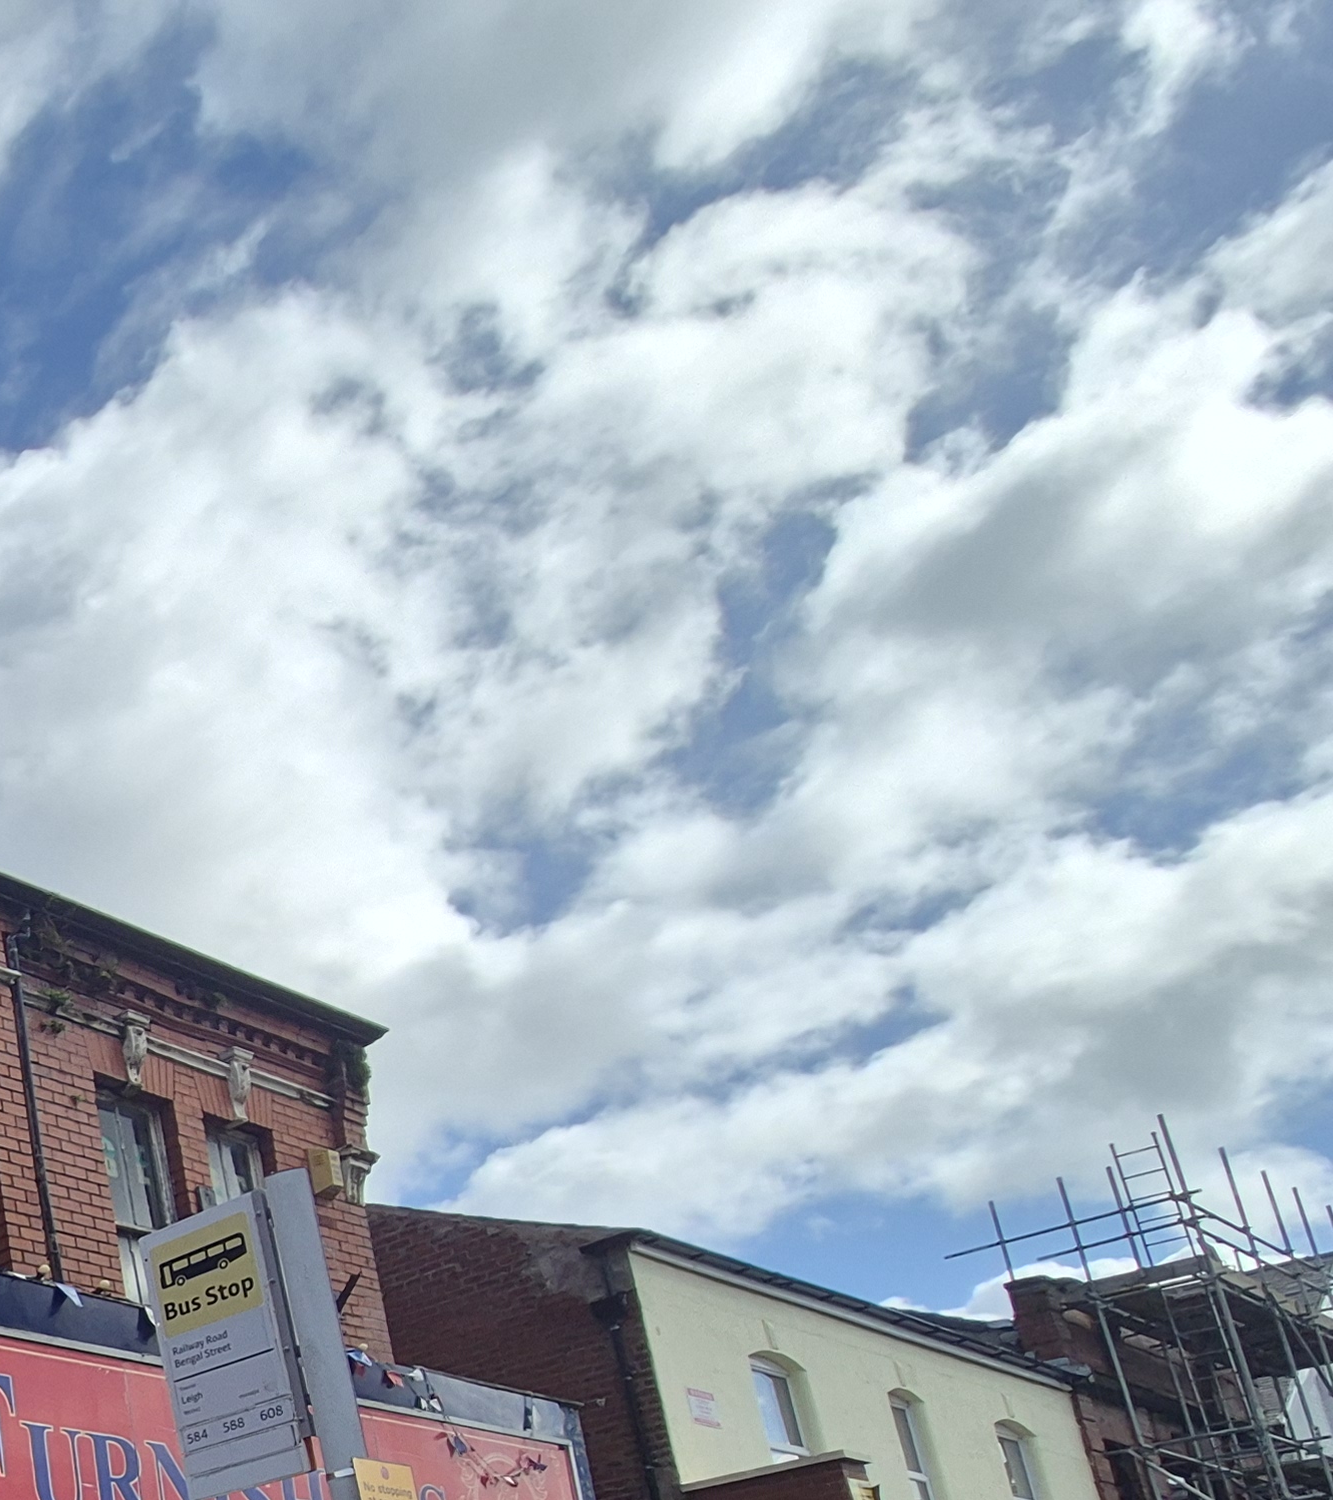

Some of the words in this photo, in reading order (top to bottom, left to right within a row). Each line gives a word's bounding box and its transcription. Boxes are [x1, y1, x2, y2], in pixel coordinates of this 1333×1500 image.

[163, 1294, 202, 1321] Bus
[205, 1275, 255, 1308] Stop
[172, 1340, 204, 1356] Railway
[206, 1330, 228, 1344] Road
[174, 1351, 203, 1368] Bengal
[205, 1343, 232, 1358] Street
[181, 1392, 203, 1405] Leigh
[187, 1429, 208, 1444] 584
[223, 1417, 245, 1433] 588
[260, 1405, 284, 1421] 608
[378, 1484, 413, 1500] stopping
